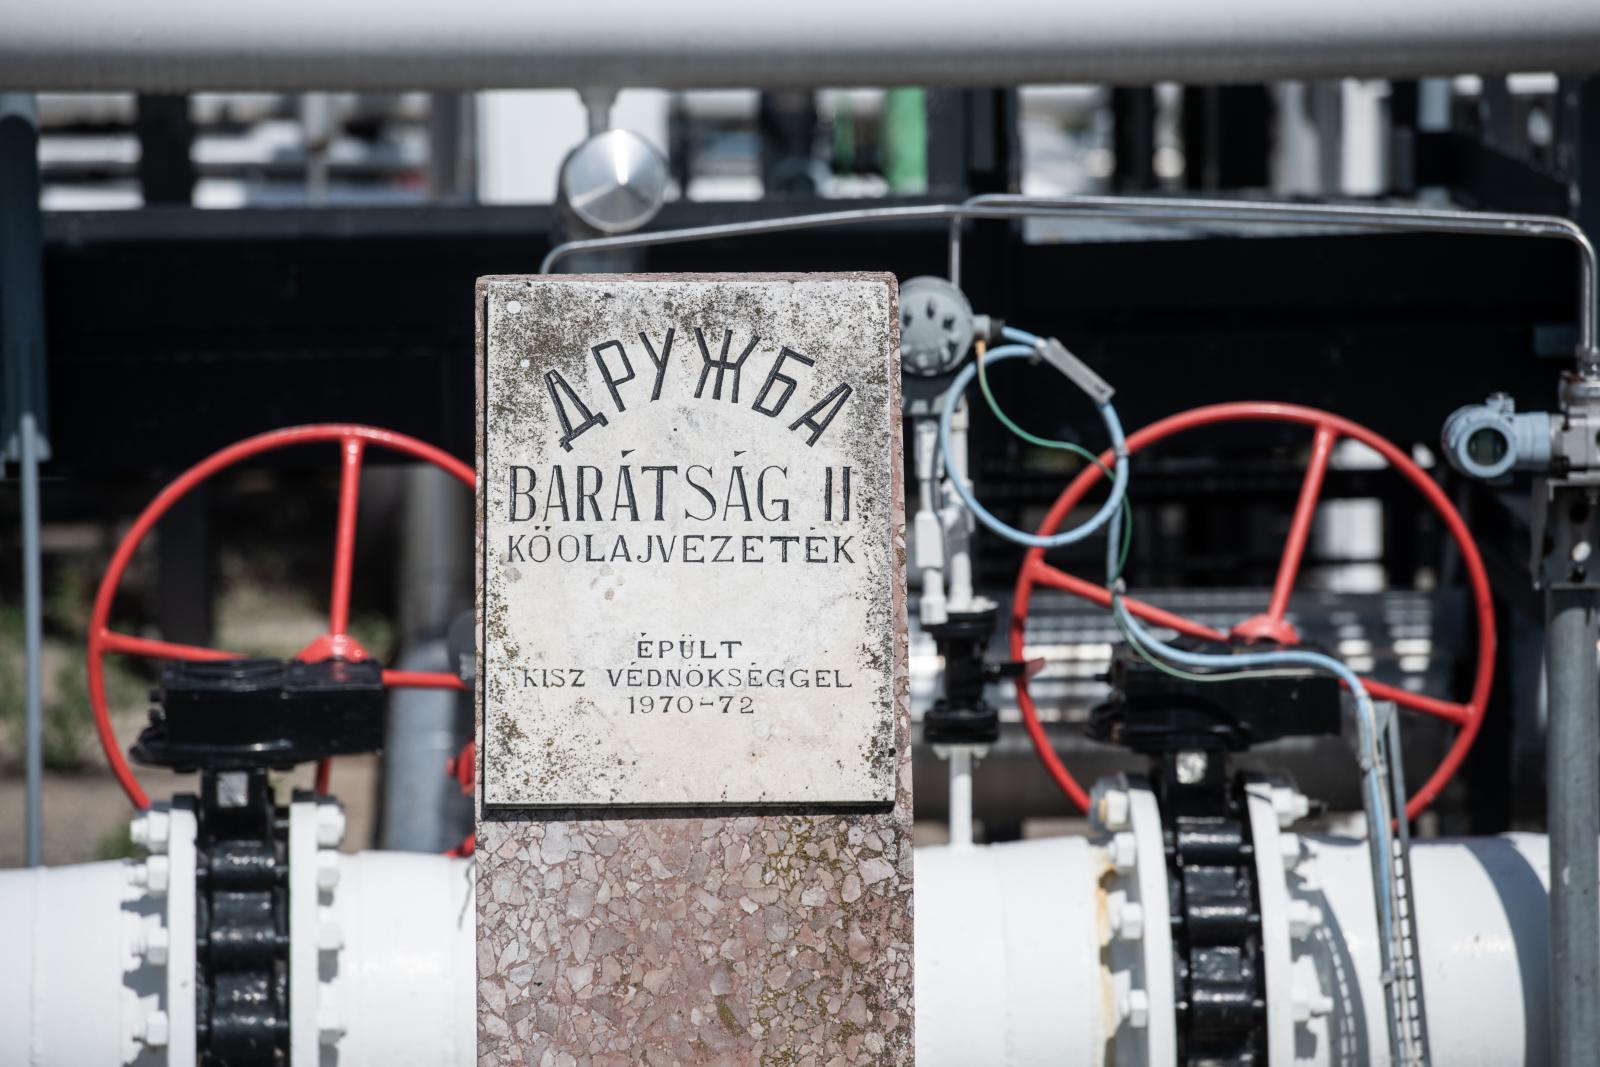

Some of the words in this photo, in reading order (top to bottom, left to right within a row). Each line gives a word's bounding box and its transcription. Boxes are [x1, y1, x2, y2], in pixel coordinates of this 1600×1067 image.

[543, 327, 854, 453] ДРУЖБА
[508, 449, 791, 523] BARÁTSÁG
[636, 631, 744, 660] ÉPÜLT
[522, 668, 586, 689] KISZ
